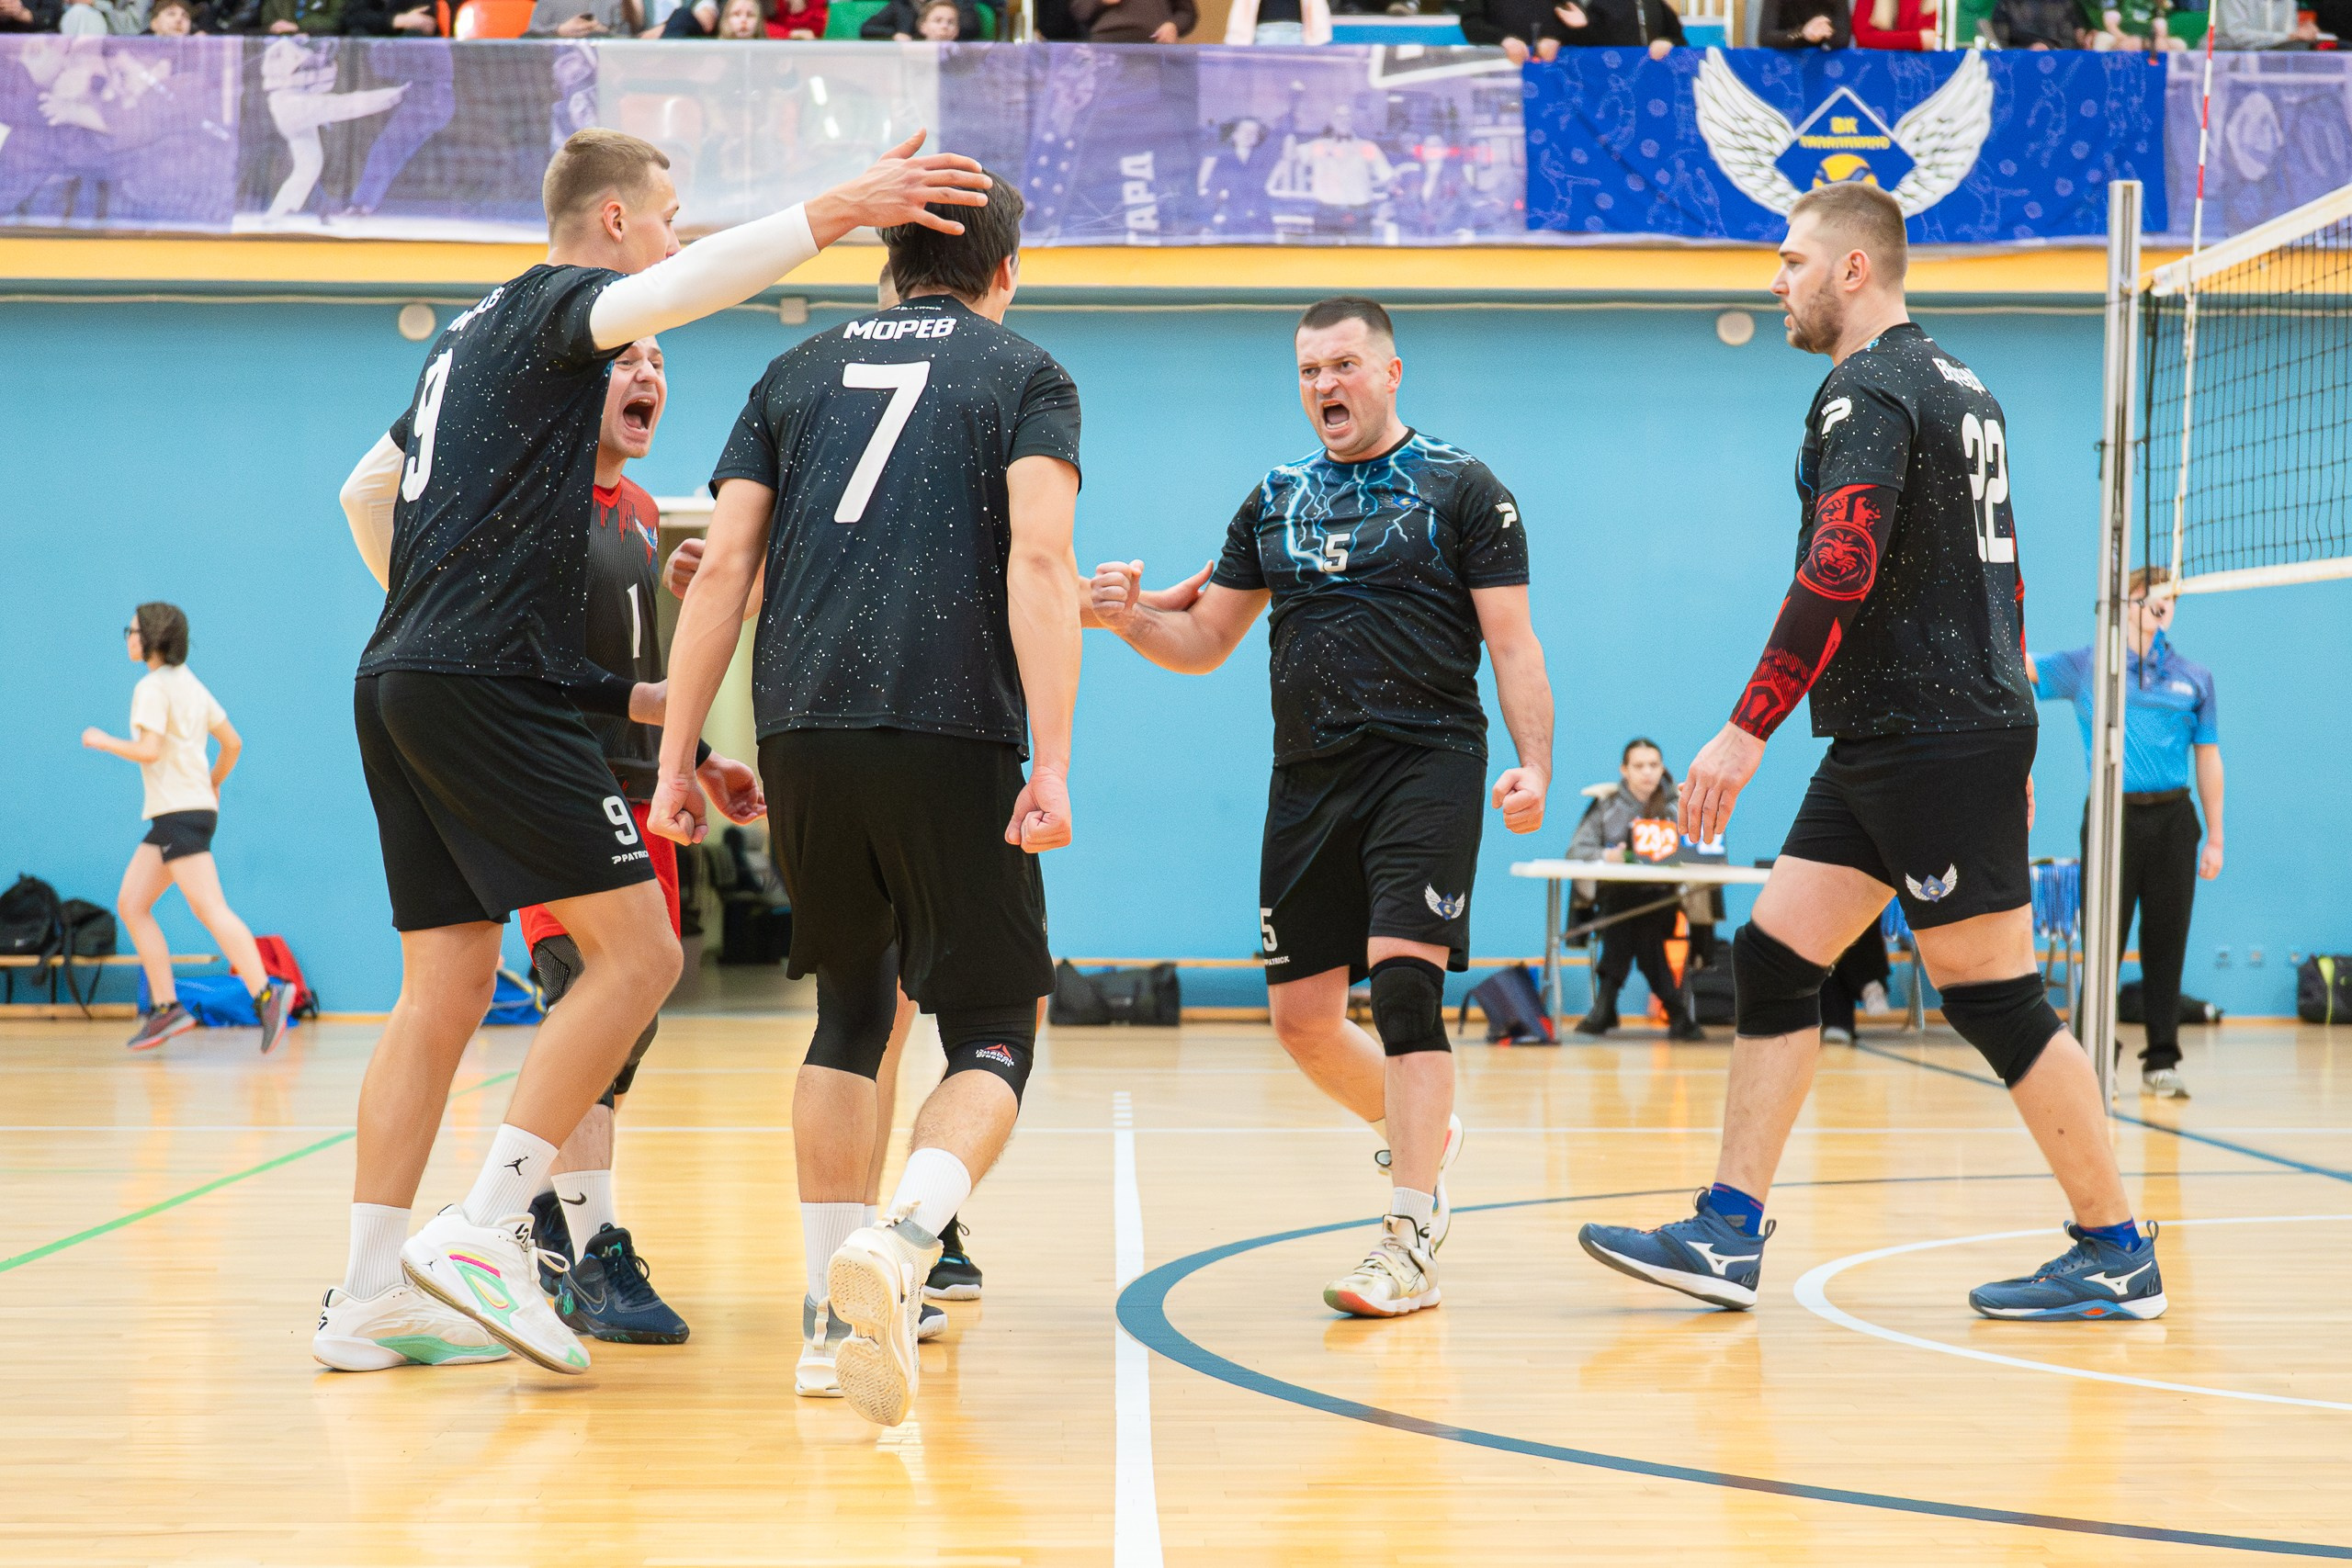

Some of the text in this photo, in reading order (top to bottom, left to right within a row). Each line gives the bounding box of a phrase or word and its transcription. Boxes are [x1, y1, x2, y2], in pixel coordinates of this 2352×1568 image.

[842, 318, 956, 340] МОРЕВ
[401, 347, 453, 503] 9
[833, 360, 931, 524] 7
[1962, 412, 2015, 563] 22
[1323, 533, 1351, 572] 5
[627, 582, 641, 659] 1
[603, 795, 639, 845] 9
[1260, 908, 1278, 952] 5
